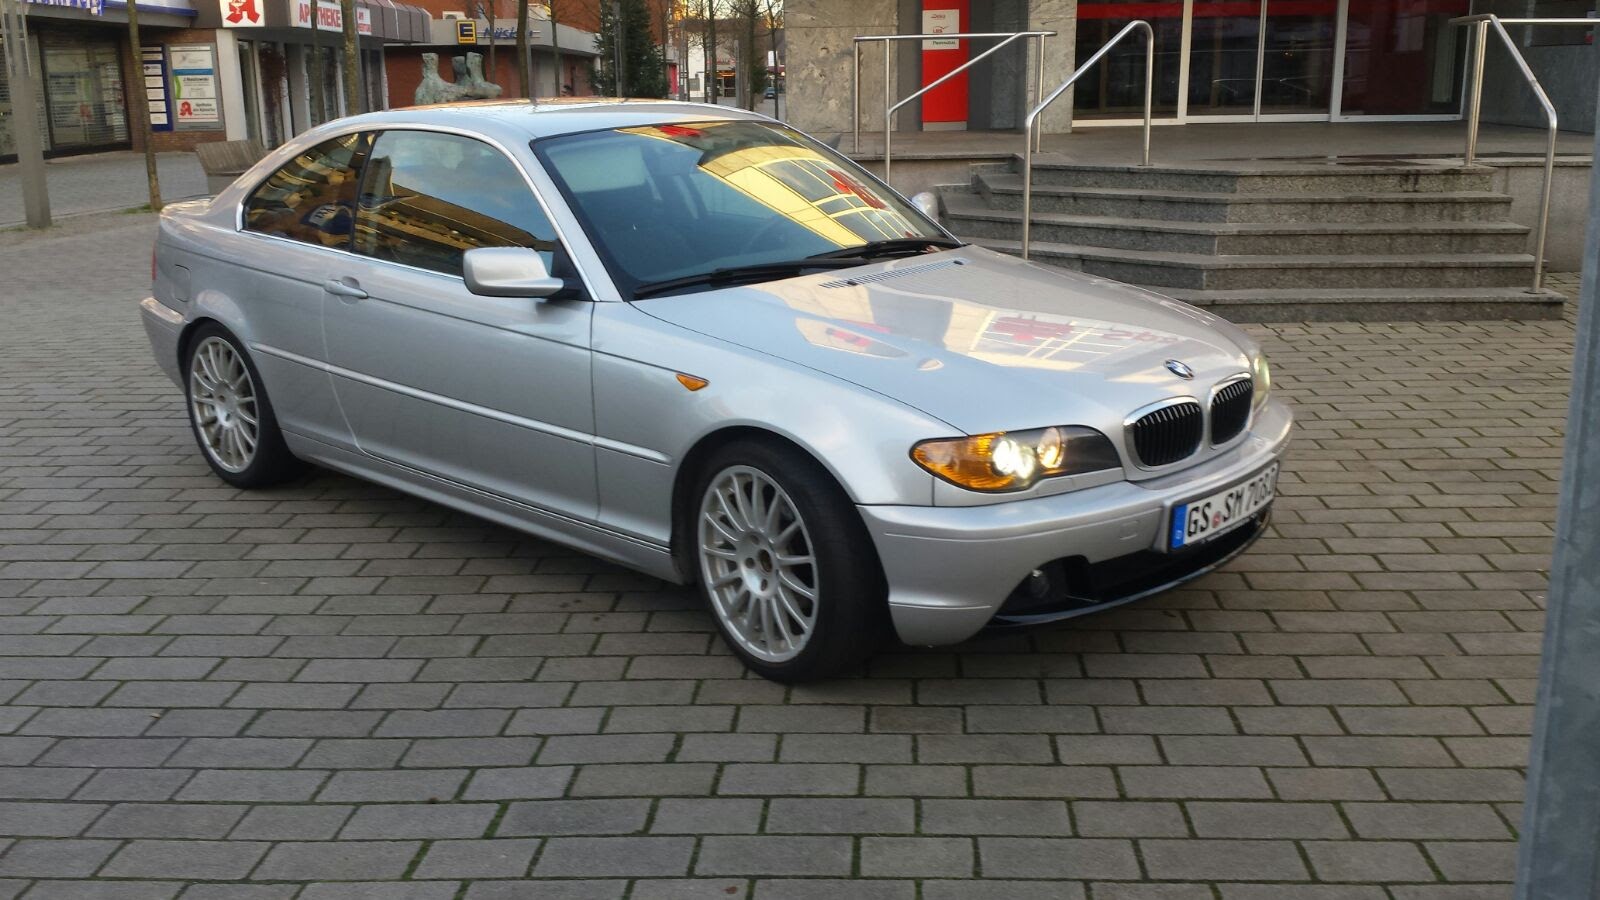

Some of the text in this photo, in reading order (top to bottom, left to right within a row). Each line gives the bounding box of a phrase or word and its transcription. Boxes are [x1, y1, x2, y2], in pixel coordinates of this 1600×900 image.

[299, 3, 341, 28] APTHEKE
[1188, 502, 1211, 537] GS
[1223, 488, 1245, 522] SM
